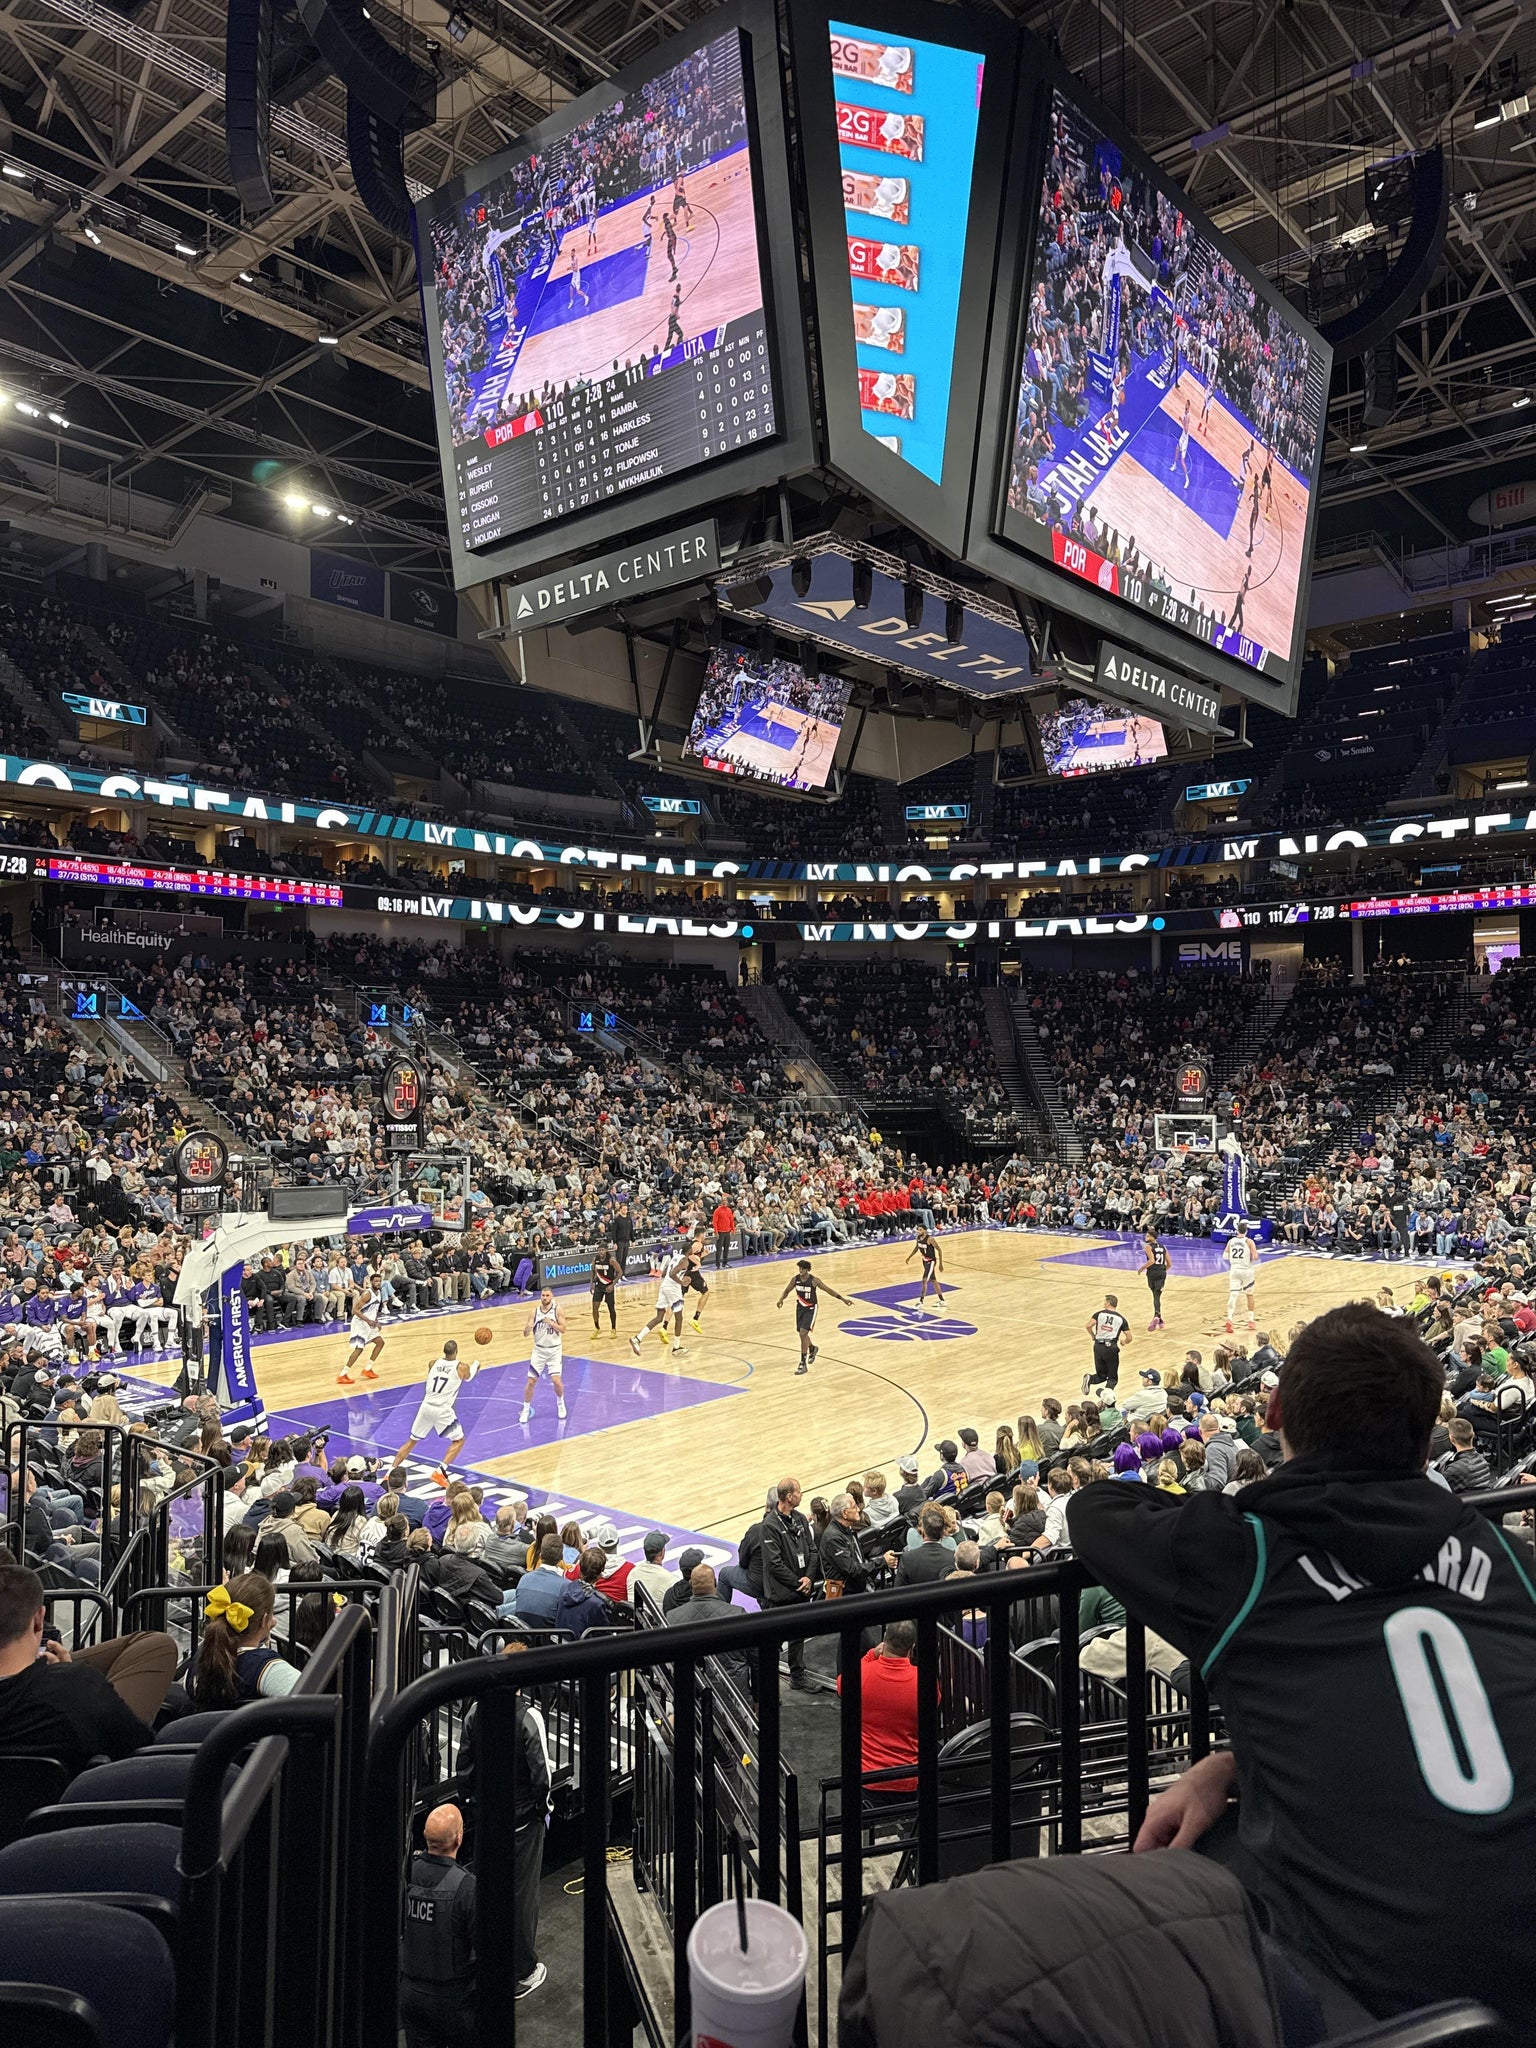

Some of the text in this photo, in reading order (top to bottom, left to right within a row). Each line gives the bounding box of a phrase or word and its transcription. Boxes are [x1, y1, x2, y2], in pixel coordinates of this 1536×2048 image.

[844, 64, 858, 73] BAR
[854, 132, 868, 142] BAR
[495, 424, 514, 443] POR
[546, 400, 564, 422] 110
[584, 384, 602, 404] 7:28
[606, 380, 616, 393] 24
[624, 364, 644, 386] 111
[683, 336, 706, 360] UTA
[535, 428, 544, 436] PTS
[694, 356, 704, 366] PTS
[467, 462, 492, 480] WESLEY
[574, 424, 582, 435] 15
[600, 414, 606, 424] 11
[611, 400, 638, 418] BAMBA
[740, 350, 751, 363] 00
[459, 492, 466, 500] 21
[469, 480, 493, 497] RUPERT
[574, 441, 584, 452] 05
[600, 431, 608, 441] 16
[612, 413, 651, 436] HARKLESS
[743, 370, 752, 381] 13
[461, 507, 468, 516] 91
[471, 495, 498, 513] CISSOKO
[578, 460, 584, 469] 11
[602, 449, 610, 459] 17
[614, 437, 640, 454] TONJE
[743, 390, 755, 402] 02
[462, 523, 470, 532] 23
[473, 511, 500, 529] CLINGAN
[580, 476, 587, 486] 21
[604, 466, 613, 477] 22
[616, 448, 658, 472] FILIPOWSKI
[745, 410, 756, 420] 23
[474, 528, 502, 545] HOLIDAY
[543, 508, 552, 518] 24
[581, 494, 589, 504] 27
[606, 484, 614, 495] 10
[748, 430, 758, 440] 18
[1496, 488, 1525, 510] bill
[538, 536, 708, 610] DELTA CENTER
[1064, 540, 1087, 573] POR
[1124, 574, 1142, 603] 110
[1161, 596, 1178, 622] 7:28
[1180, 608, 1190, 624] 24
[1196, 614, 1212, 640] 111
[1239, 636, 1254, 662] UTA
[858, 616, 1025, 680] DELTA
[1120, 662, 1217, 719] DELTA CENTER
[90, 700, 120, 718] LVT
[1206, 782, 1230, 797] LVT
[660, 799, 682, 812] LVT
[924, 806, 948, 818] LVT
[424, 824, 457, 846] LVT
[1224, 839, 1260, 860] LVT
[0, 856, 27, 874] 7:28
[36, 858, 46, 867] 24
[58, 862, 78, 870] 34/75
[106, 866, 126, 875] 18/45
[806, 863, 838, 880] LVT
[33, 868, 47, 877] 4TH
[58, 871, 79, 880] 37/73
[108, 876, 125, 884] 11/31
[377, 897, 418, 914] 09:16 PM
[421, 897, 454, 917] LVT
[1243, 912, 1260, 925] 110
[1268, 910, 1283, 923] 111
[1314, 906, 1335, 920] 7:28
[81, 928, 172, 950] HealthEquity
[804, 924, 835, 940] LVT
[1179, 942, 1241, 961] SME
[1182, 1078, 1200, 1092] 24
[394, 1086, 416, 1112] 24
[394, 1124, 417, 1132] TISSOT
[189, 1160, 212, 1177] 24
[193, 1186, 222, 1194] TISSOT
[1156, 1254, 1164, 1265] 21
[1232, 1249, 1244, 1259] 22
[1105, 1316, 1114, 1325] 14
[231, 1288, 248, 1388] AMERICA FIRST
[433, 1376, 448, 1394] 17
[1383, 1606, 1513, 1815] 0
[408, 1900, 434, 1922] LICE
